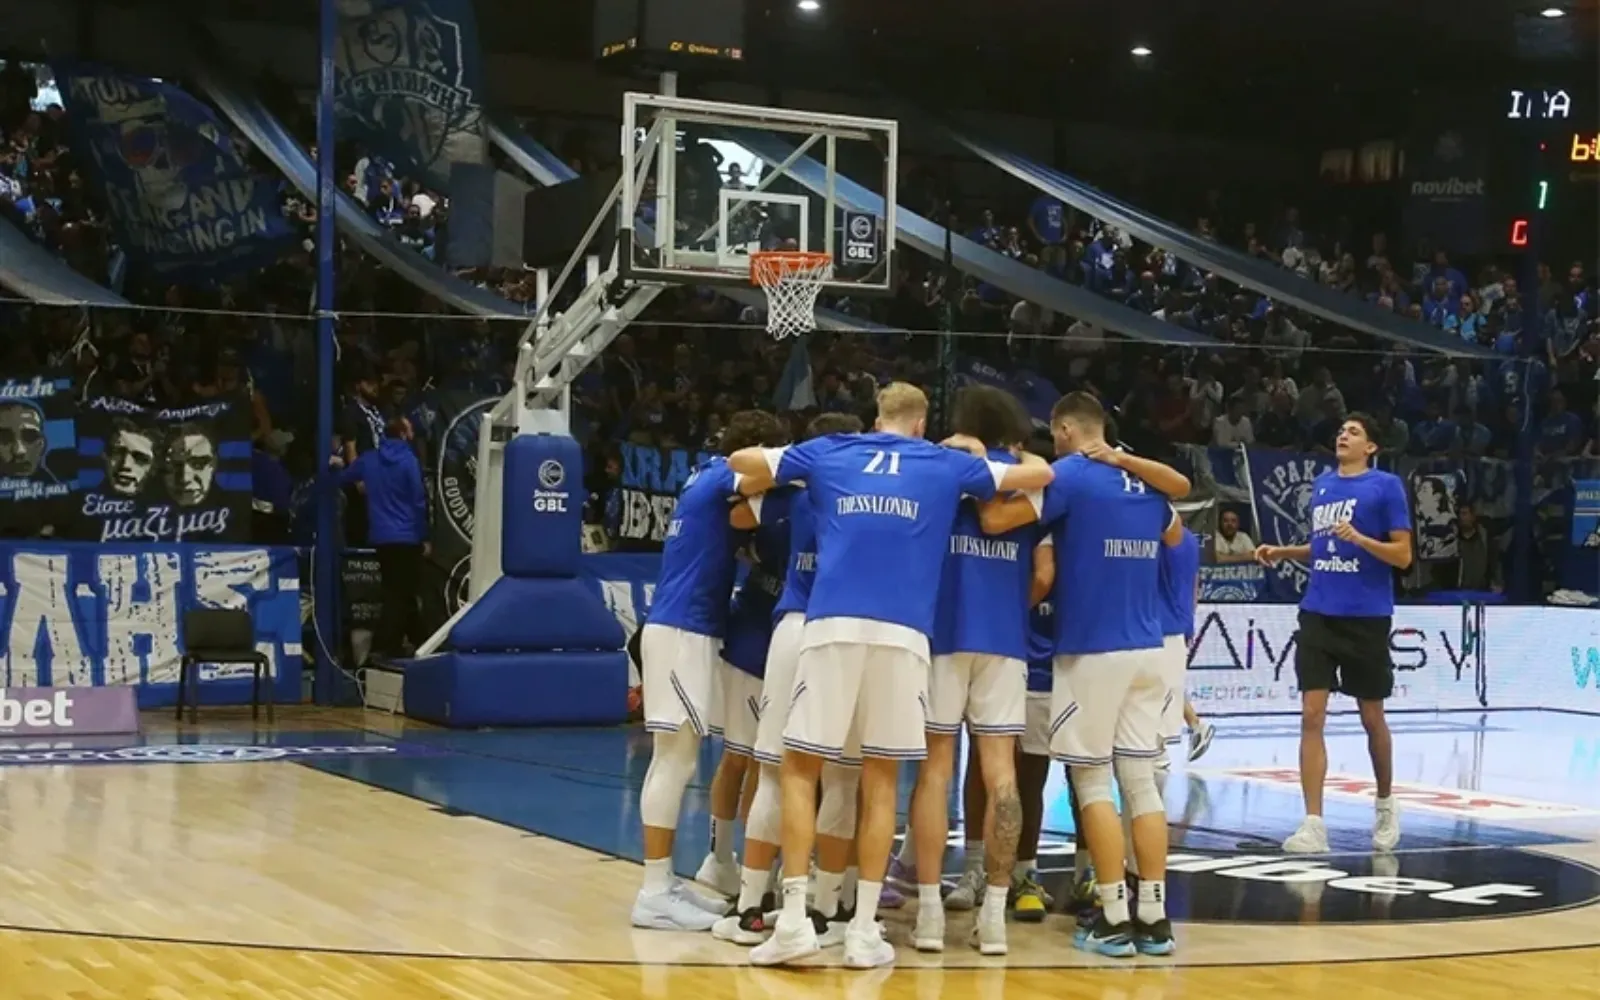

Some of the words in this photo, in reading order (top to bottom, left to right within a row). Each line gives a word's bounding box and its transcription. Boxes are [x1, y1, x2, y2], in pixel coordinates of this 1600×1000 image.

[1411, 176, 1485, 196] novibet
[848, 246, 873, 259] GBL
[862, 450, 900, 475] 21
[82, 493, 135, 516] Είστε
[534, 498, 567, 512] GBL
[836, 495, 920, 520] THESSALONIKI
[101, 506, 172, 544] μαζί
[175, 507, 231, 544] μας
[1313, 556, 1360, 572] ovibet
